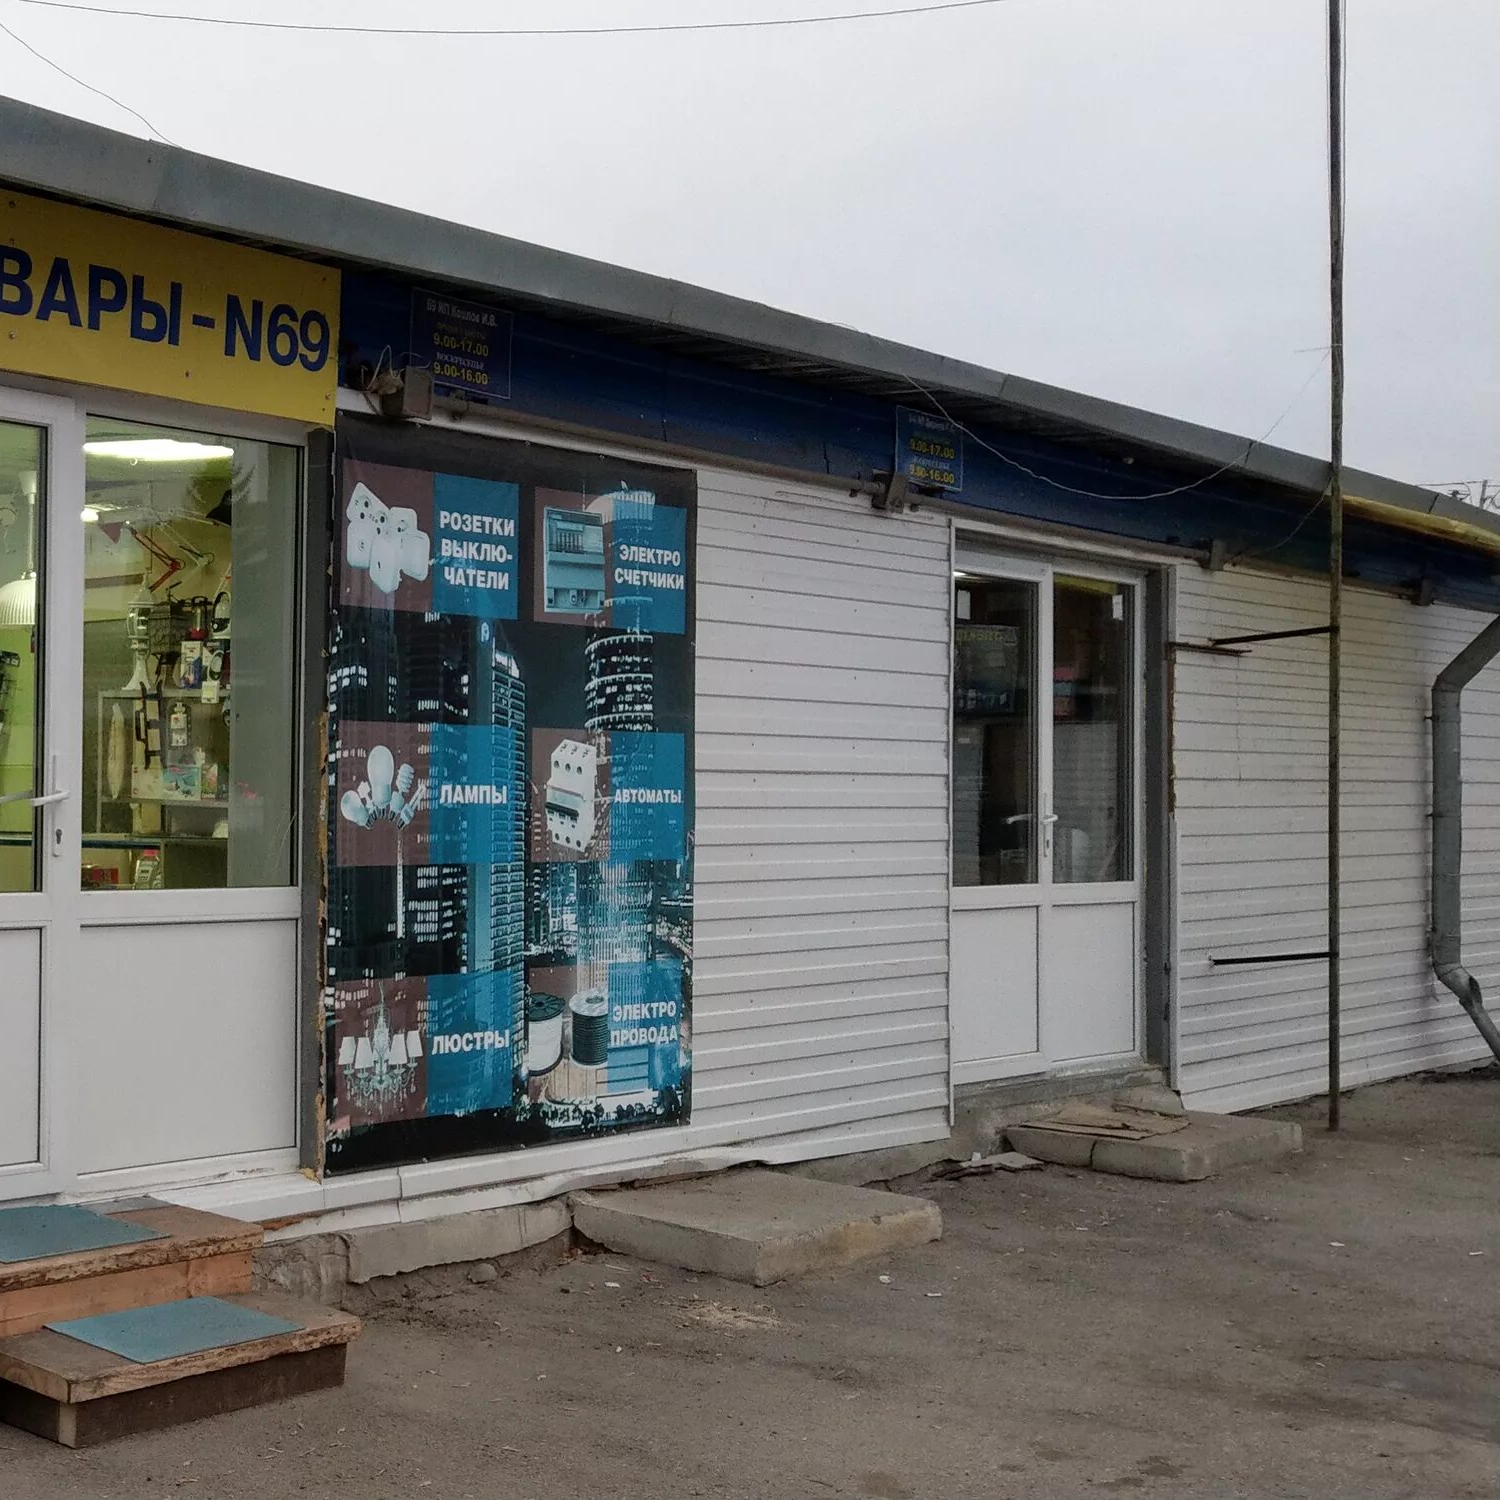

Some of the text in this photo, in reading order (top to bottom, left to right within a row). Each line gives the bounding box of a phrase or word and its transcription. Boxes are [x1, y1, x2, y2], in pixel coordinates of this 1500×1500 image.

[433, 361, 489, 386] 9.00-16.00
[439, 510, 515, 538] РОЗЕТКИ
[440, 538, 513, 564] ВЫКЛЮ-
[619, 543, 681, 567] ЭЛЕКТРО
[443, 566, 510, 591] ЧАТЕЛИ
[614, 567, 685, 591] СЧЕТЧИКИ
[439, 784, 508, 806] ЛАМПЫ
[613, 787, 682, 804] АВТОМАТЫ
[612, 1000, 677, 1022] ЭЛЕКТРО
[431, 1029, 510, 1056] ЛЮСТРЫ
[610, 1023, 678, 1048] ПРОВОДА
